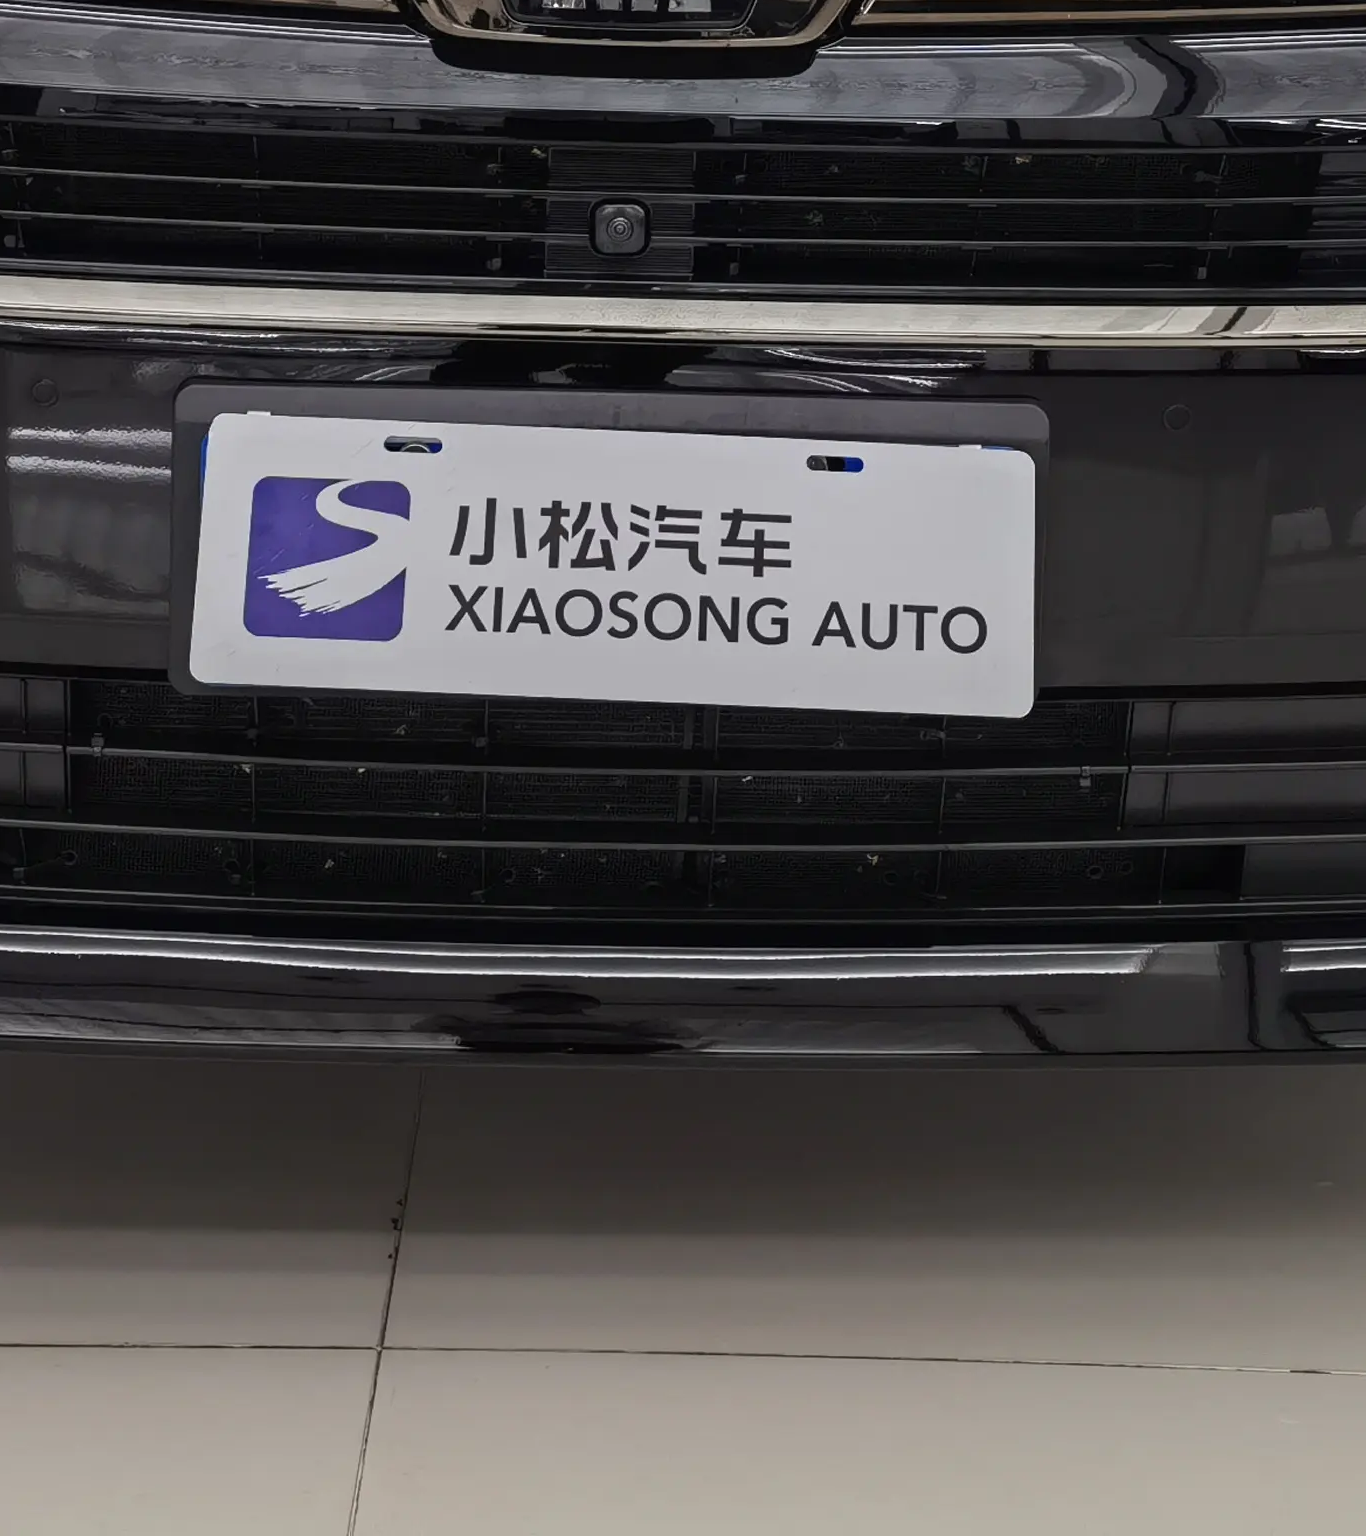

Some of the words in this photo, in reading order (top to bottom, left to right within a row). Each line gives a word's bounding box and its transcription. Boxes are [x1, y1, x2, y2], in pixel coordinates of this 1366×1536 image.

[449, 497, 792, 577] 小松汽车
[444, 583, 789, 646] XIAOSONG
[811, 600, 988, 654] AUTO
